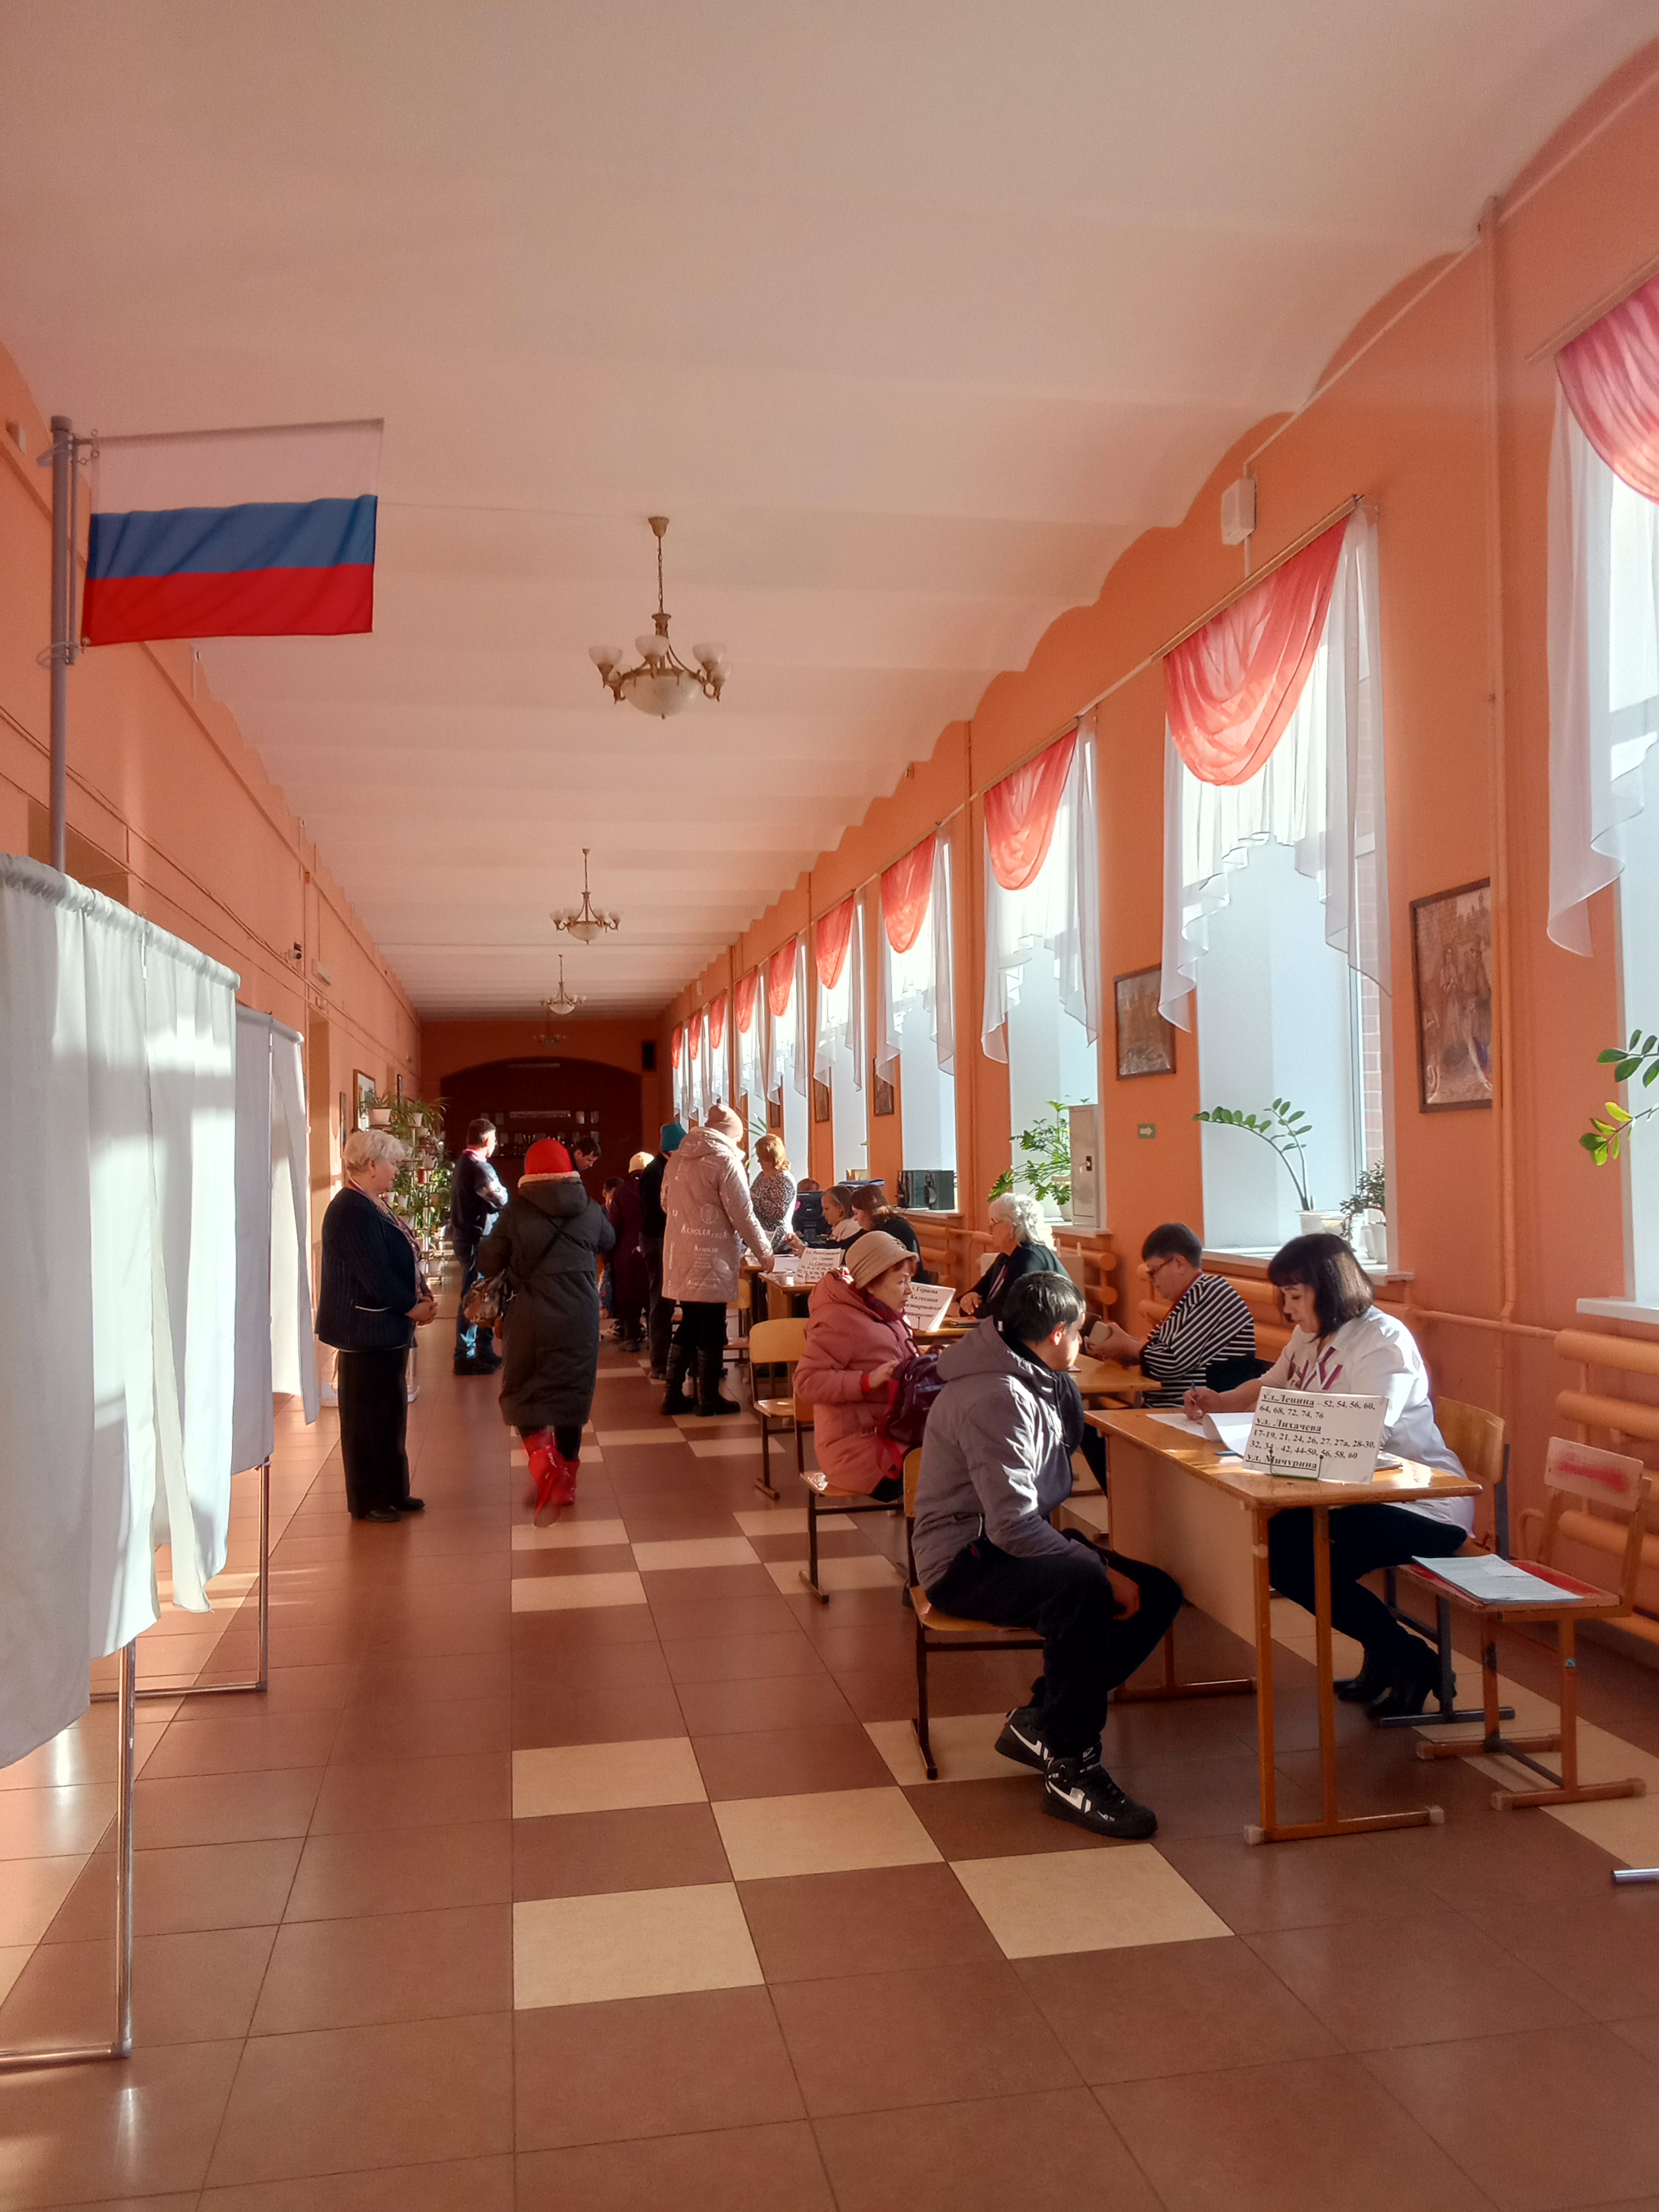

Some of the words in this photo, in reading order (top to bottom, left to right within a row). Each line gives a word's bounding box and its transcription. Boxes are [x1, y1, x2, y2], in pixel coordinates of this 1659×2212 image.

[1260, 1406, 1271, 1414] 64,
[1364, 1402, 1375, 1410] 60,
[1256, 1417, 1271, 1425] ул.
[1273, 1419, 1322, 1432] Лихачева
[1254, 1429, 1277, 1439] 17-19,
[1279, 1433, 1290, 1441] 21,
[1353, 1440, 1376, 1448] 28-30,
[1250, 1441, 1262, 1449] 32,
[1281, 1445, 1292, 1453] 42,
[1294, 1448, 1318, 1456] 44-50,
[1321, 1450, 1332, 1458] 56,
[1265, 1455, 1317, 1469] Мичурина
